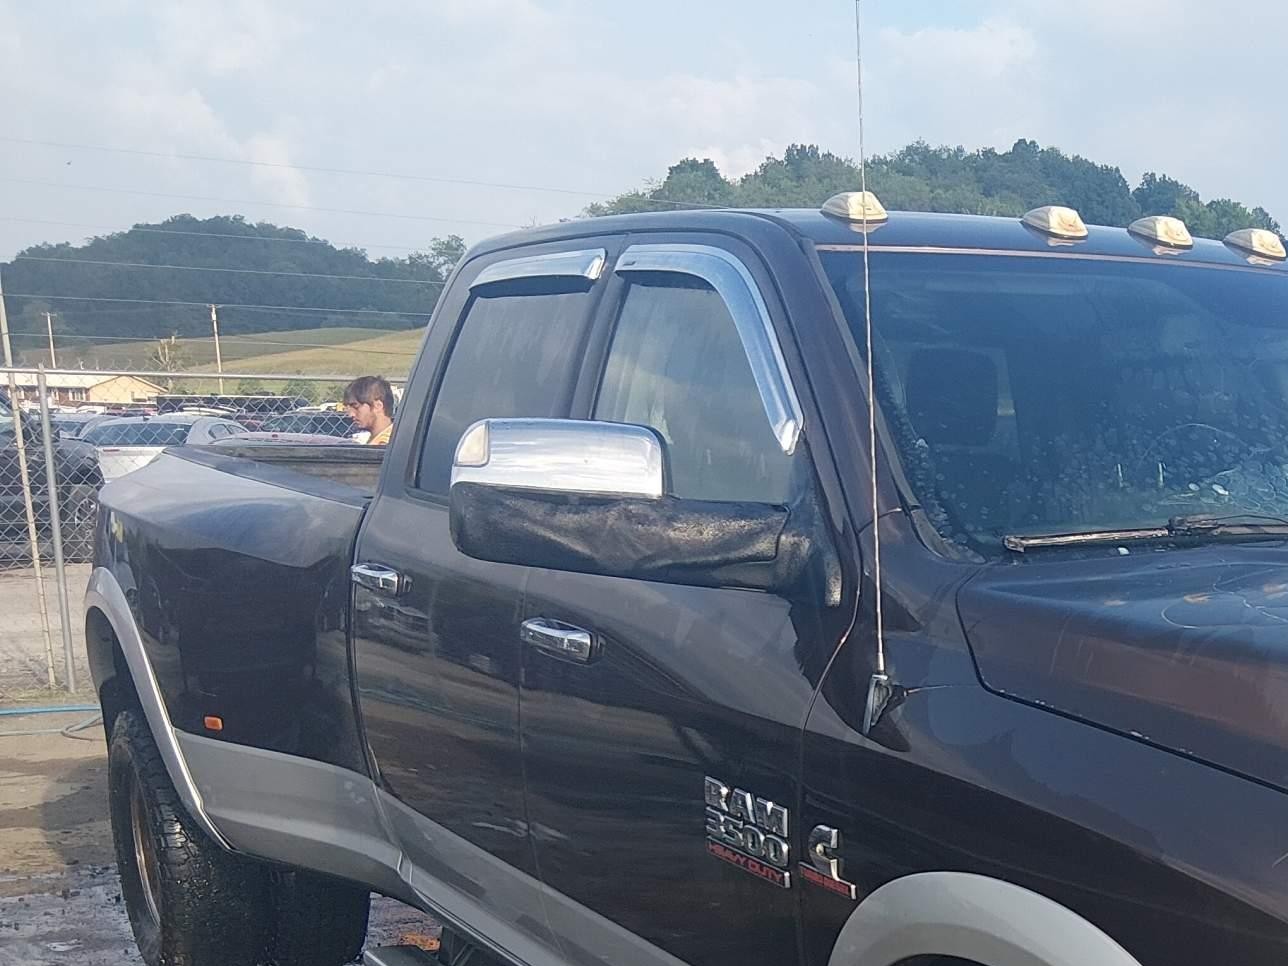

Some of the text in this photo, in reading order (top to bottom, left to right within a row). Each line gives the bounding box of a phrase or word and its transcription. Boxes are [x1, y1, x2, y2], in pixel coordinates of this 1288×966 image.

[704, 776, 788, 837] RAM
[705, 806, 790, 867] 3500
[708, 840, 747, 868] HEAVY
[748, 860, 784, 883] DUTY
